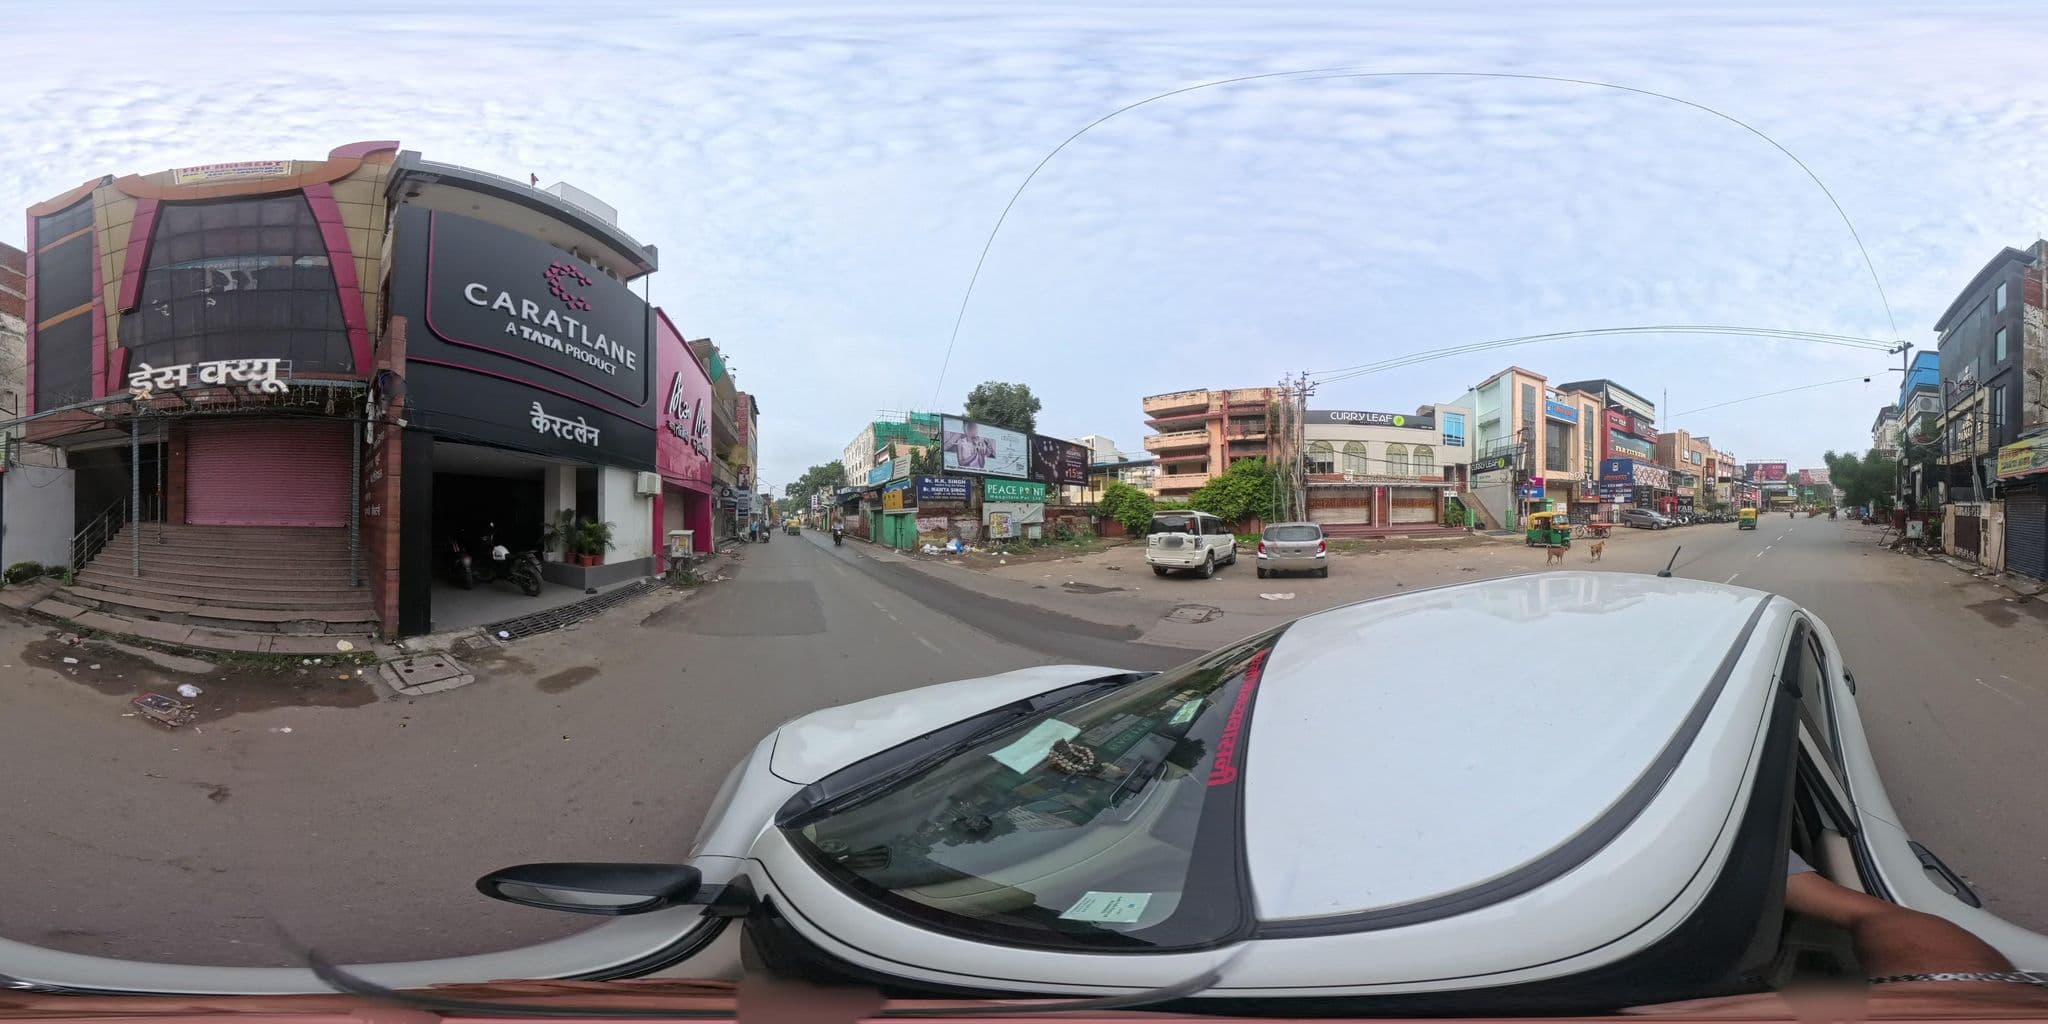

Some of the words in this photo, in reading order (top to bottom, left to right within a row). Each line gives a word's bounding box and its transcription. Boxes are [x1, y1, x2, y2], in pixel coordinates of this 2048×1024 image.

[464, 283, 636, 370] CARATLANE
[505, 322, 517, 335] A
[519, 325, 563, 351] TATA
[565, 343, 616, 375] PRODUCT
[529, 401, 600, 446] कैरटलेन
[1330, 411, 1364, 421] CURRY
[1367, 413, 1392, 422] LEAF
[987, 484, 1017, 495] PEACE
